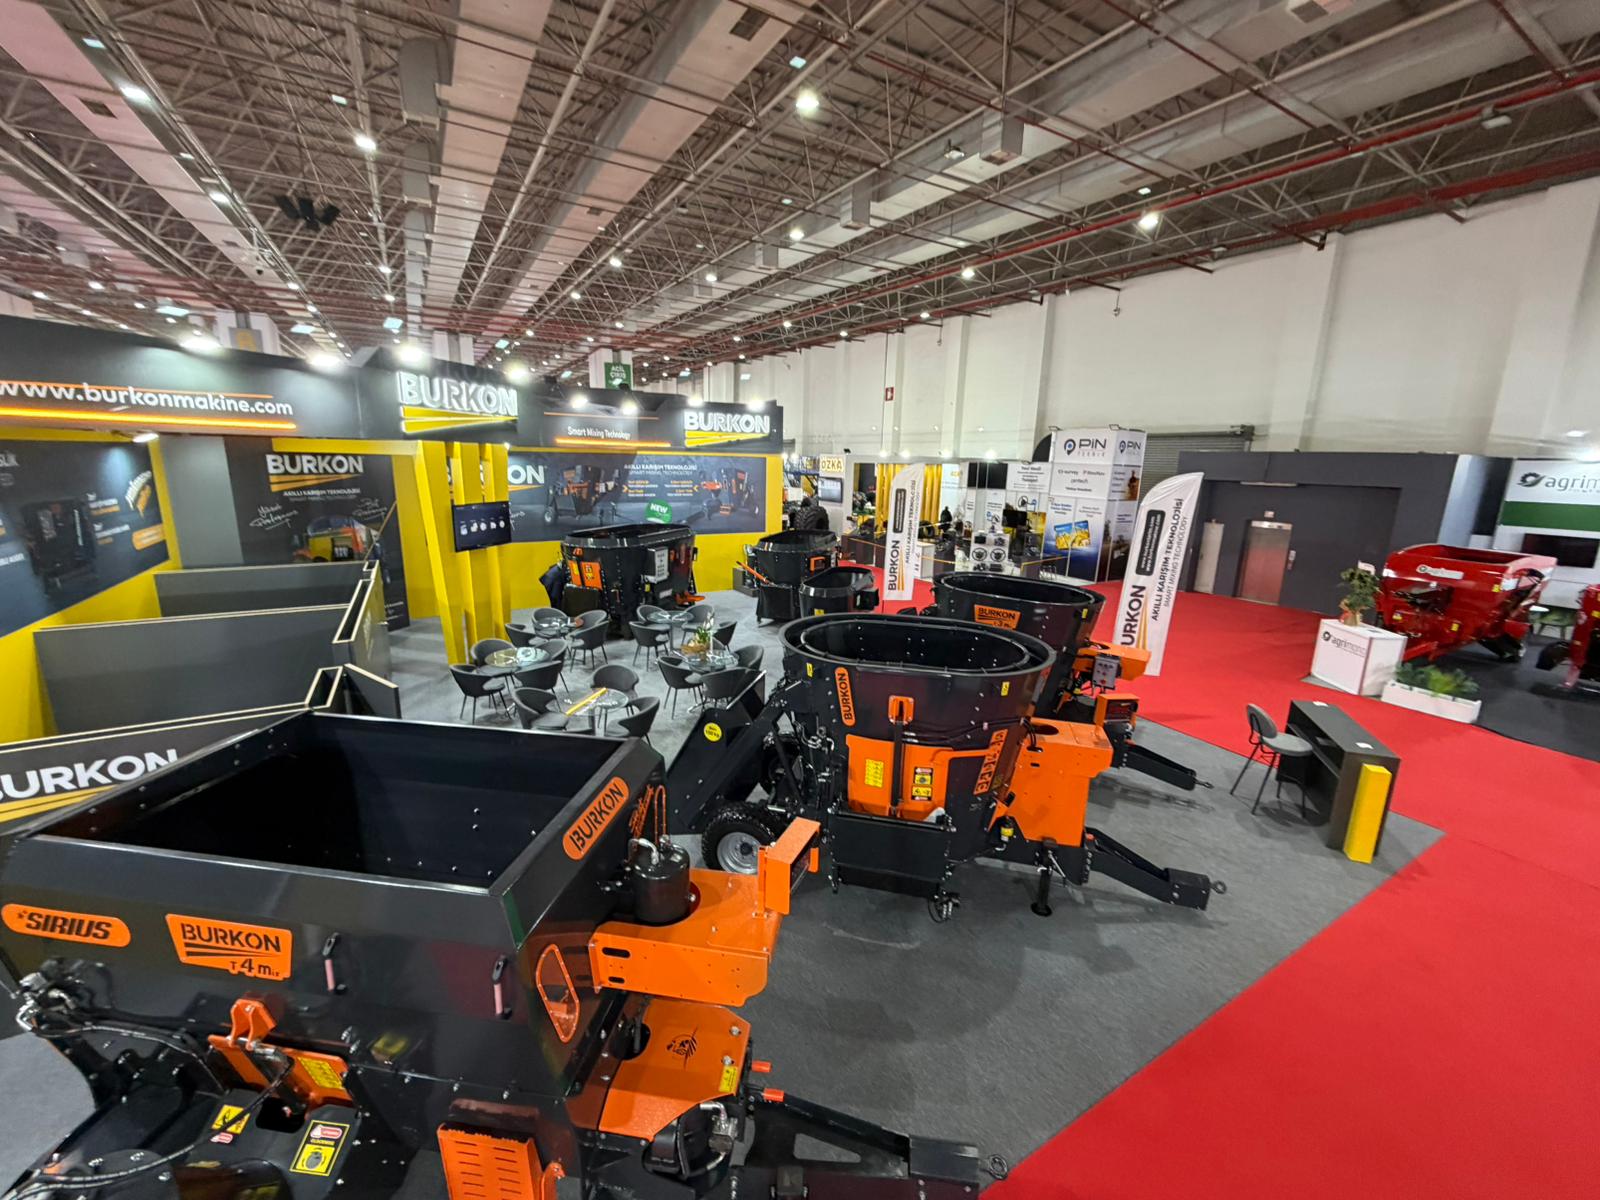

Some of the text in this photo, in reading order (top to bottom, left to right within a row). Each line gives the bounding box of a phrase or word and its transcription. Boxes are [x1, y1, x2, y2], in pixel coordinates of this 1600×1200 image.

[0, 382, 293, 416] www.burkonmakine.com
[397, 371, 518, 416] BURKON
[568, 426, 631, 440] Smart Mixing Technology
[684, 411, 770, 433] BURKON
[266, 454, 364, 474] BURKON
[650, 503, 668, 513] NEW
[888, 540, 901, 591] BURKON
[1151, 498, 1184, 621] AKILLI KARIŞIM TEKNOLOJİSİ
[1163, 516, 1188, 607] SMART MIXING TECHNOLOGY
[978, 607, 1016, 620] BURKON
[1121, 585, 1147, 646] URKON
[837, 673, 853, 720] BURKON
[570, 783, 625, 853] BURKON
[180, 923, 281, 952] BURKON
